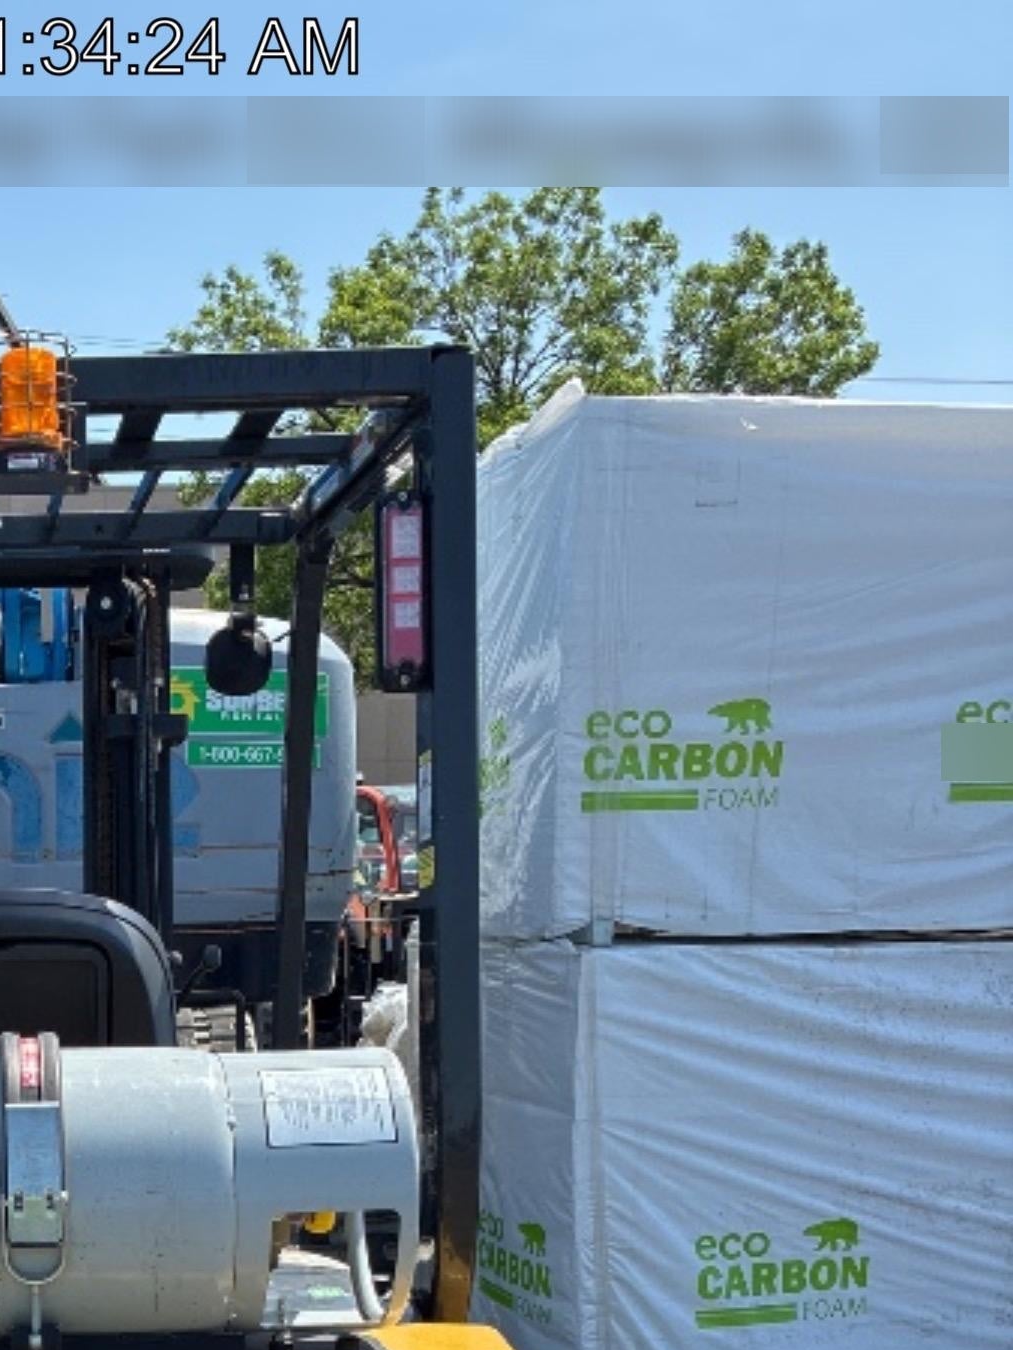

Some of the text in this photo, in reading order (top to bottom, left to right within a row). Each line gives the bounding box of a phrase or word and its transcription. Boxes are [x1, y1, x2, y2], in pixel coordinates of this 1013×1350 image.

[586, 710, 672, 739] eco
[955, 700, 1013, 724] ec
[583, 741, 784, 781] CARBON
[703, 786, 778, 810] FOAM
[695, 1232, 770, 1261] eco
[697, 1256, 870, 1300] CARBON
[802, 1298, 869, 1320] FOAM
